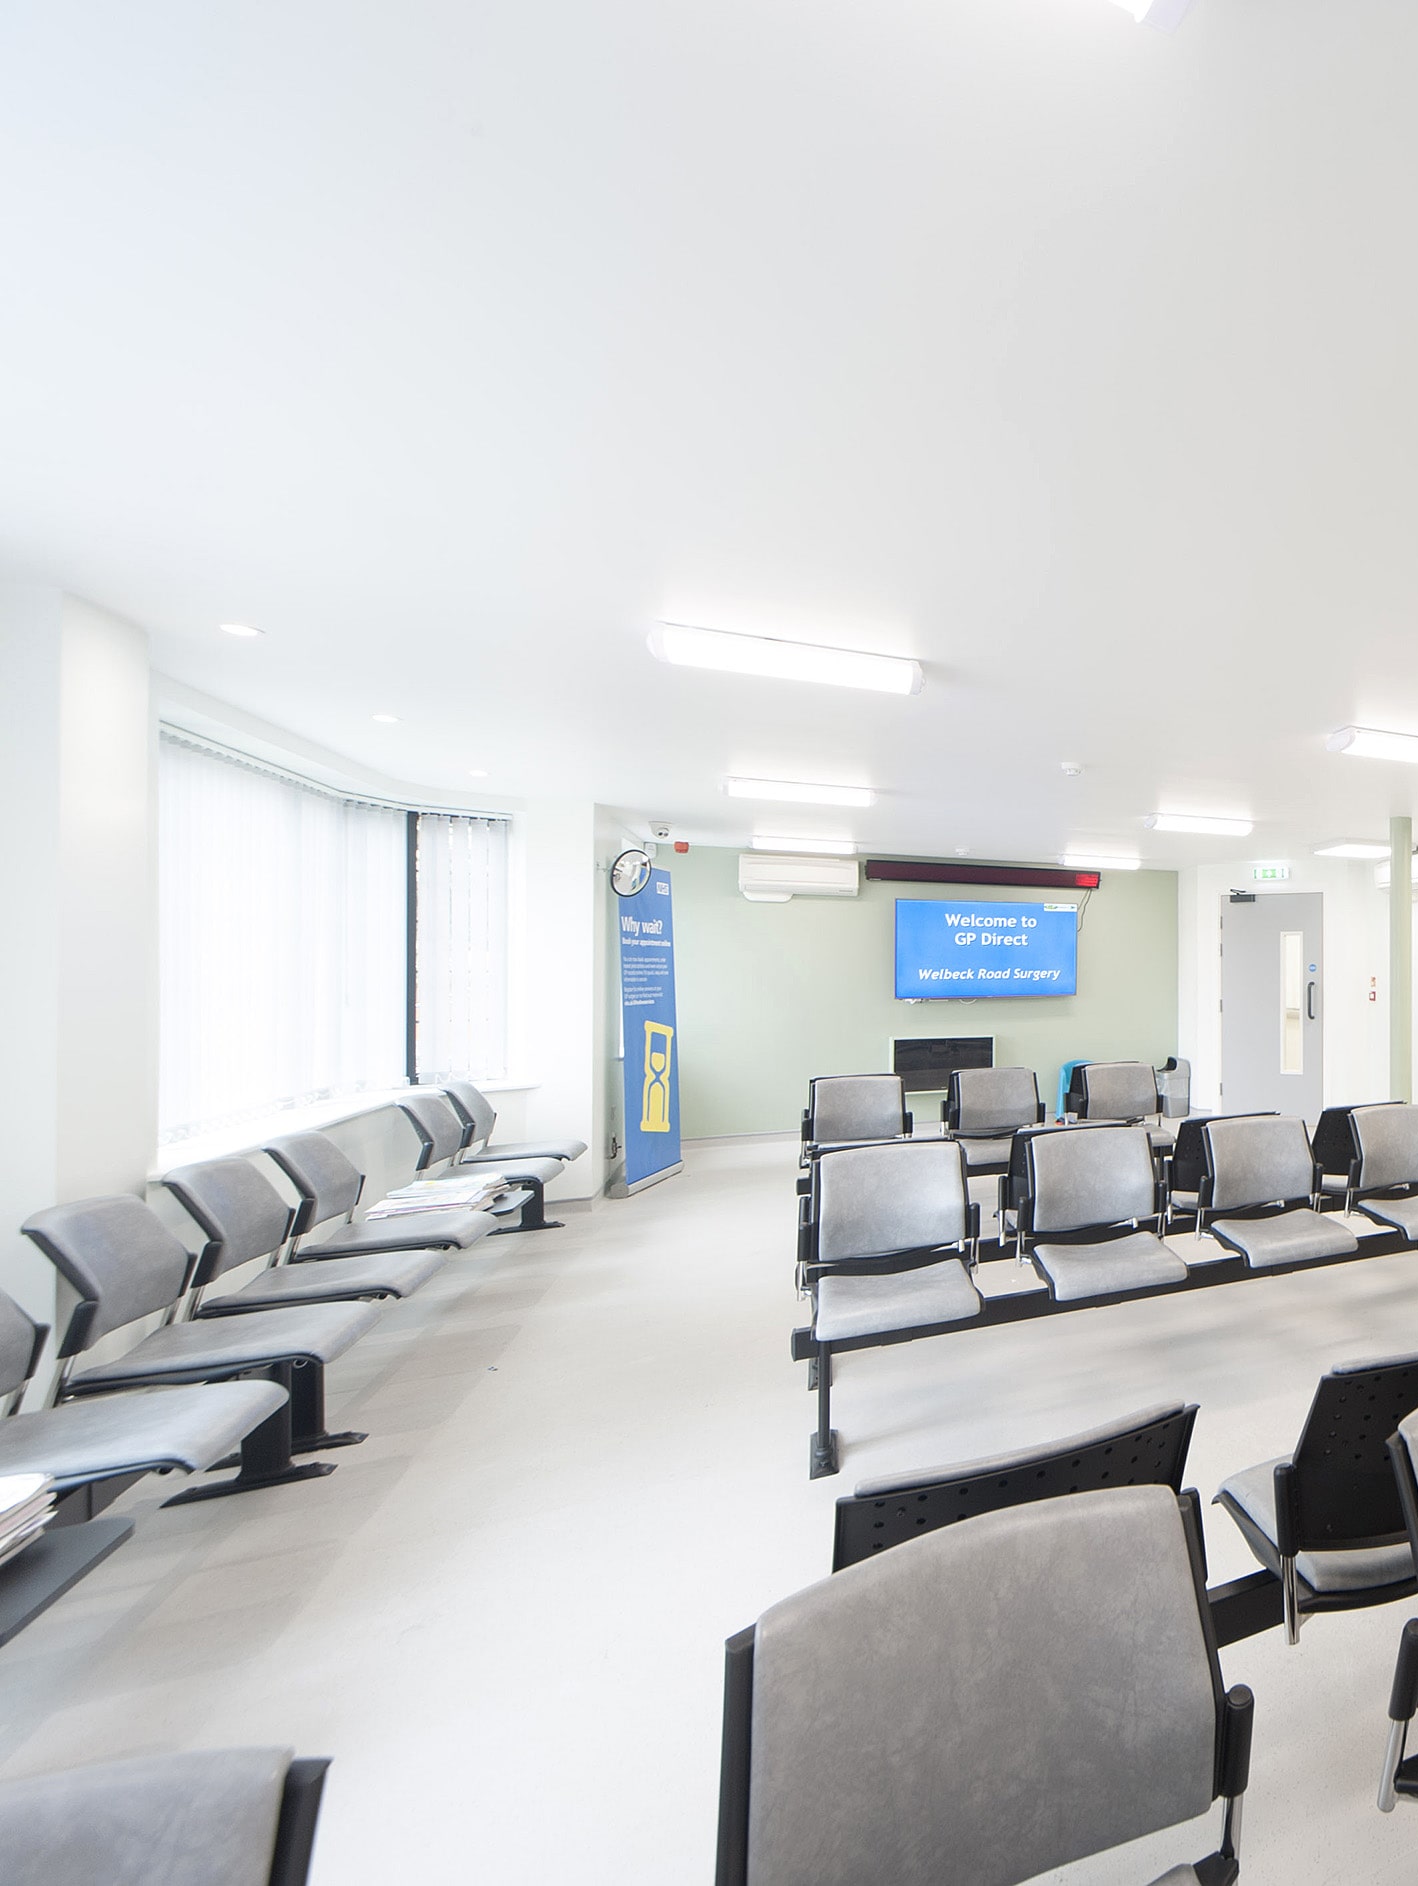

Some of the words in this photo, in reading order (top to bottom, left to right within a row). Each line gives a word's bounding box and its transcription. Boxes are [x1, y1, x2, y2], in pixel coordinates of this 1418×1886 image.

[621, 916, 640, 936] Why
[642, 919, 663, 935] wait?
[945, 913, 1017, 928] Welcome
[1021, 915, 1037, 928] to
[954, 933, 977, 946] GP
[981, 933, 1029, 946] Direct
[918, 968, 974, 980] Welbeck
[977, 968, 1010, 980] Road
[1013, 968, 1061, 981] Surgery
